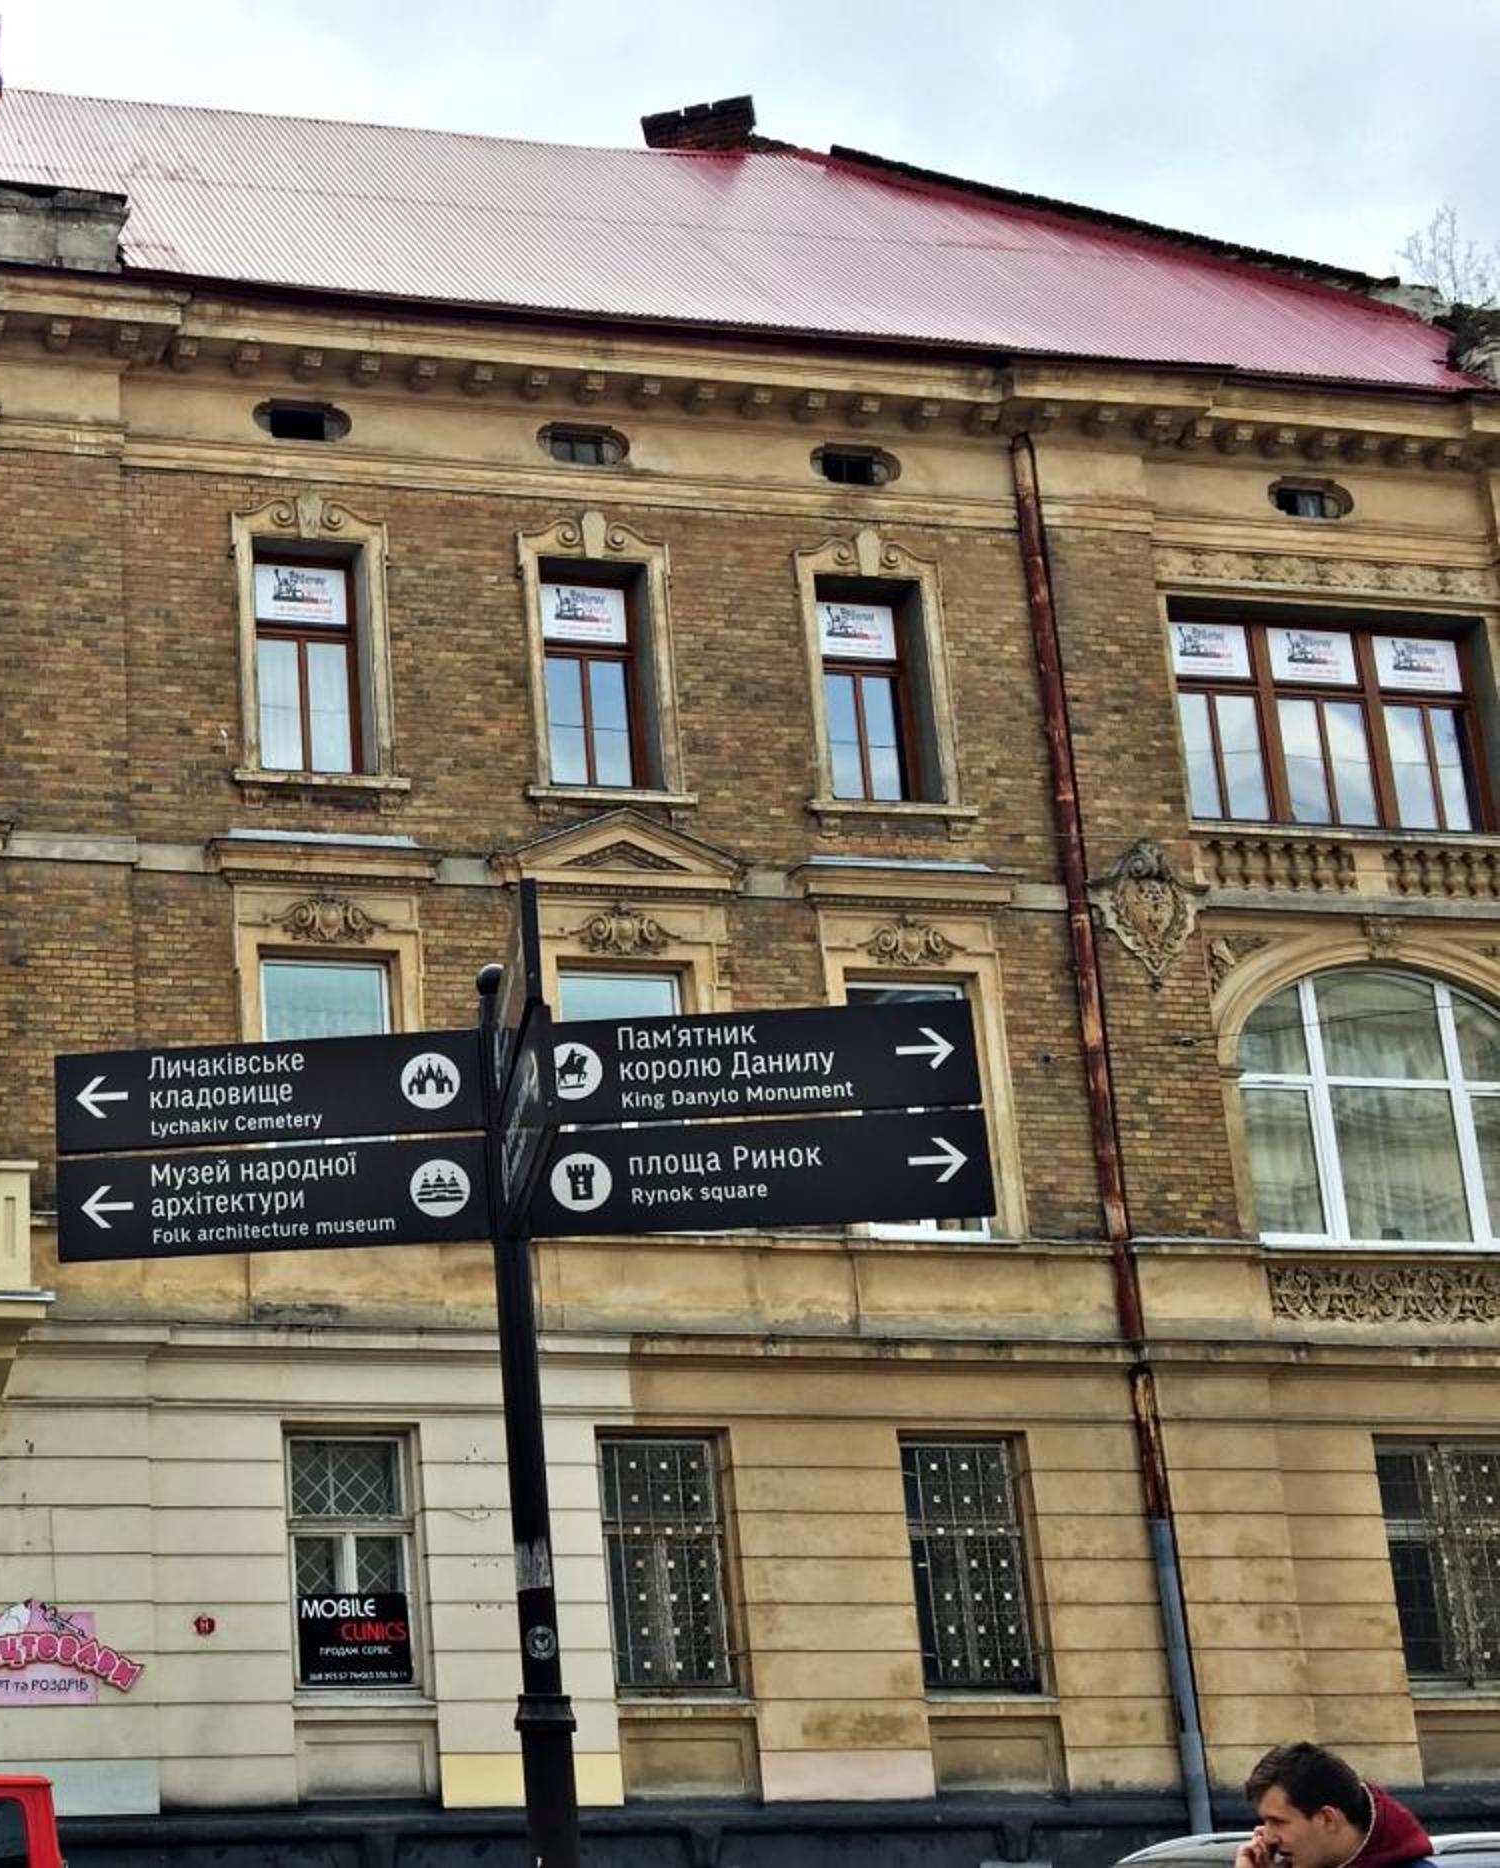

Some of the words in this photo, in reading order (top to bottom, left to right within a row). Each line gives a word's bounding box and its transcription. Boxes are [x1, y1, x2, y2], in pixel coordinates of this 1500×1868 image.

[617, 1024, 757, 1051] Пам'ятник
[148, 1052, 305, 1080] Личаківське
[619, 1056, 722, 1085] королю
[731, 1050, 835, 1080] Данилу
[150, 1082, 293, 1110] кладовище
[621, 1091, 665, 1110] King
[671, 1087, 739, 1107] Danylo
[746, 1081, 854, 1102] Monument
[150, 1116, 229, 1139] Lychakiv
[234, 1113, 323, 1132] Cemetery
[150, 1160, 231, 1190] Музей
[241, 1151, 357, 1184] народної
[628, 1151, 722, 1176] площа
[732, 1145, 823, 1171] Ринок
[151, 1189, 305, 1221] архітектури
[630, 1185, 694, 1206] Rynok
[700, 1183, 769, 1203] square
[153, 1227, 191, 1244] Folk
[197, 1219, 309, 1242] architecture
[316, 1216, 396, 1235] museum
[300, 1597, 377, 1619] MOBILE
[340, 1621, 407, 1642] CLINICS
[13, 1681, 29, 1691] та
[30, 1678, 89, 1692] РОЗДРІБ
